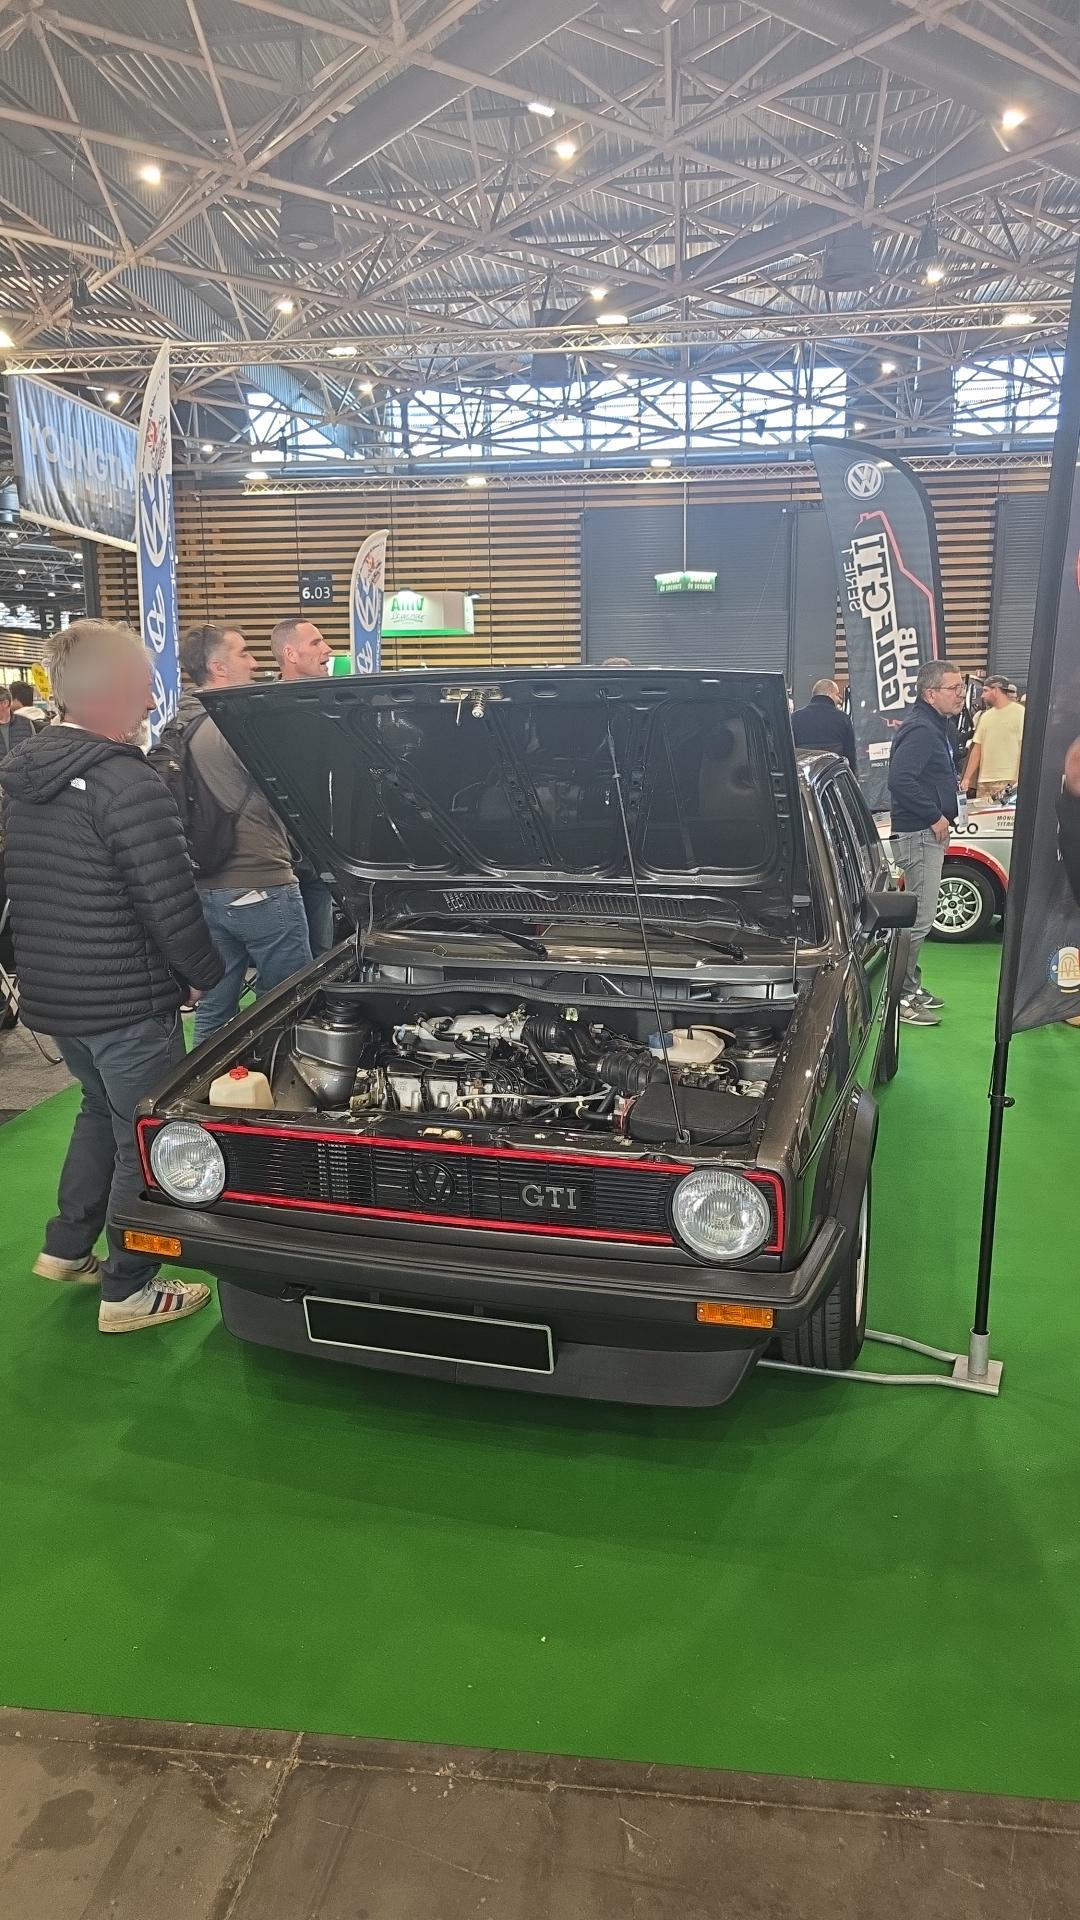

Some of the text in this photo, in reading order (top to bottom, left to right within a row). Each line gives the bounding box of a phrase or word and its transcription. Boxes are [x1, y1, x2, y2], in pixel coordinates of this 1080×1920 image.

[302, 586, 331, 600] 6.03
[46, 614, 55, 630] 5
[521, 1184, 577, 1210] GTI
